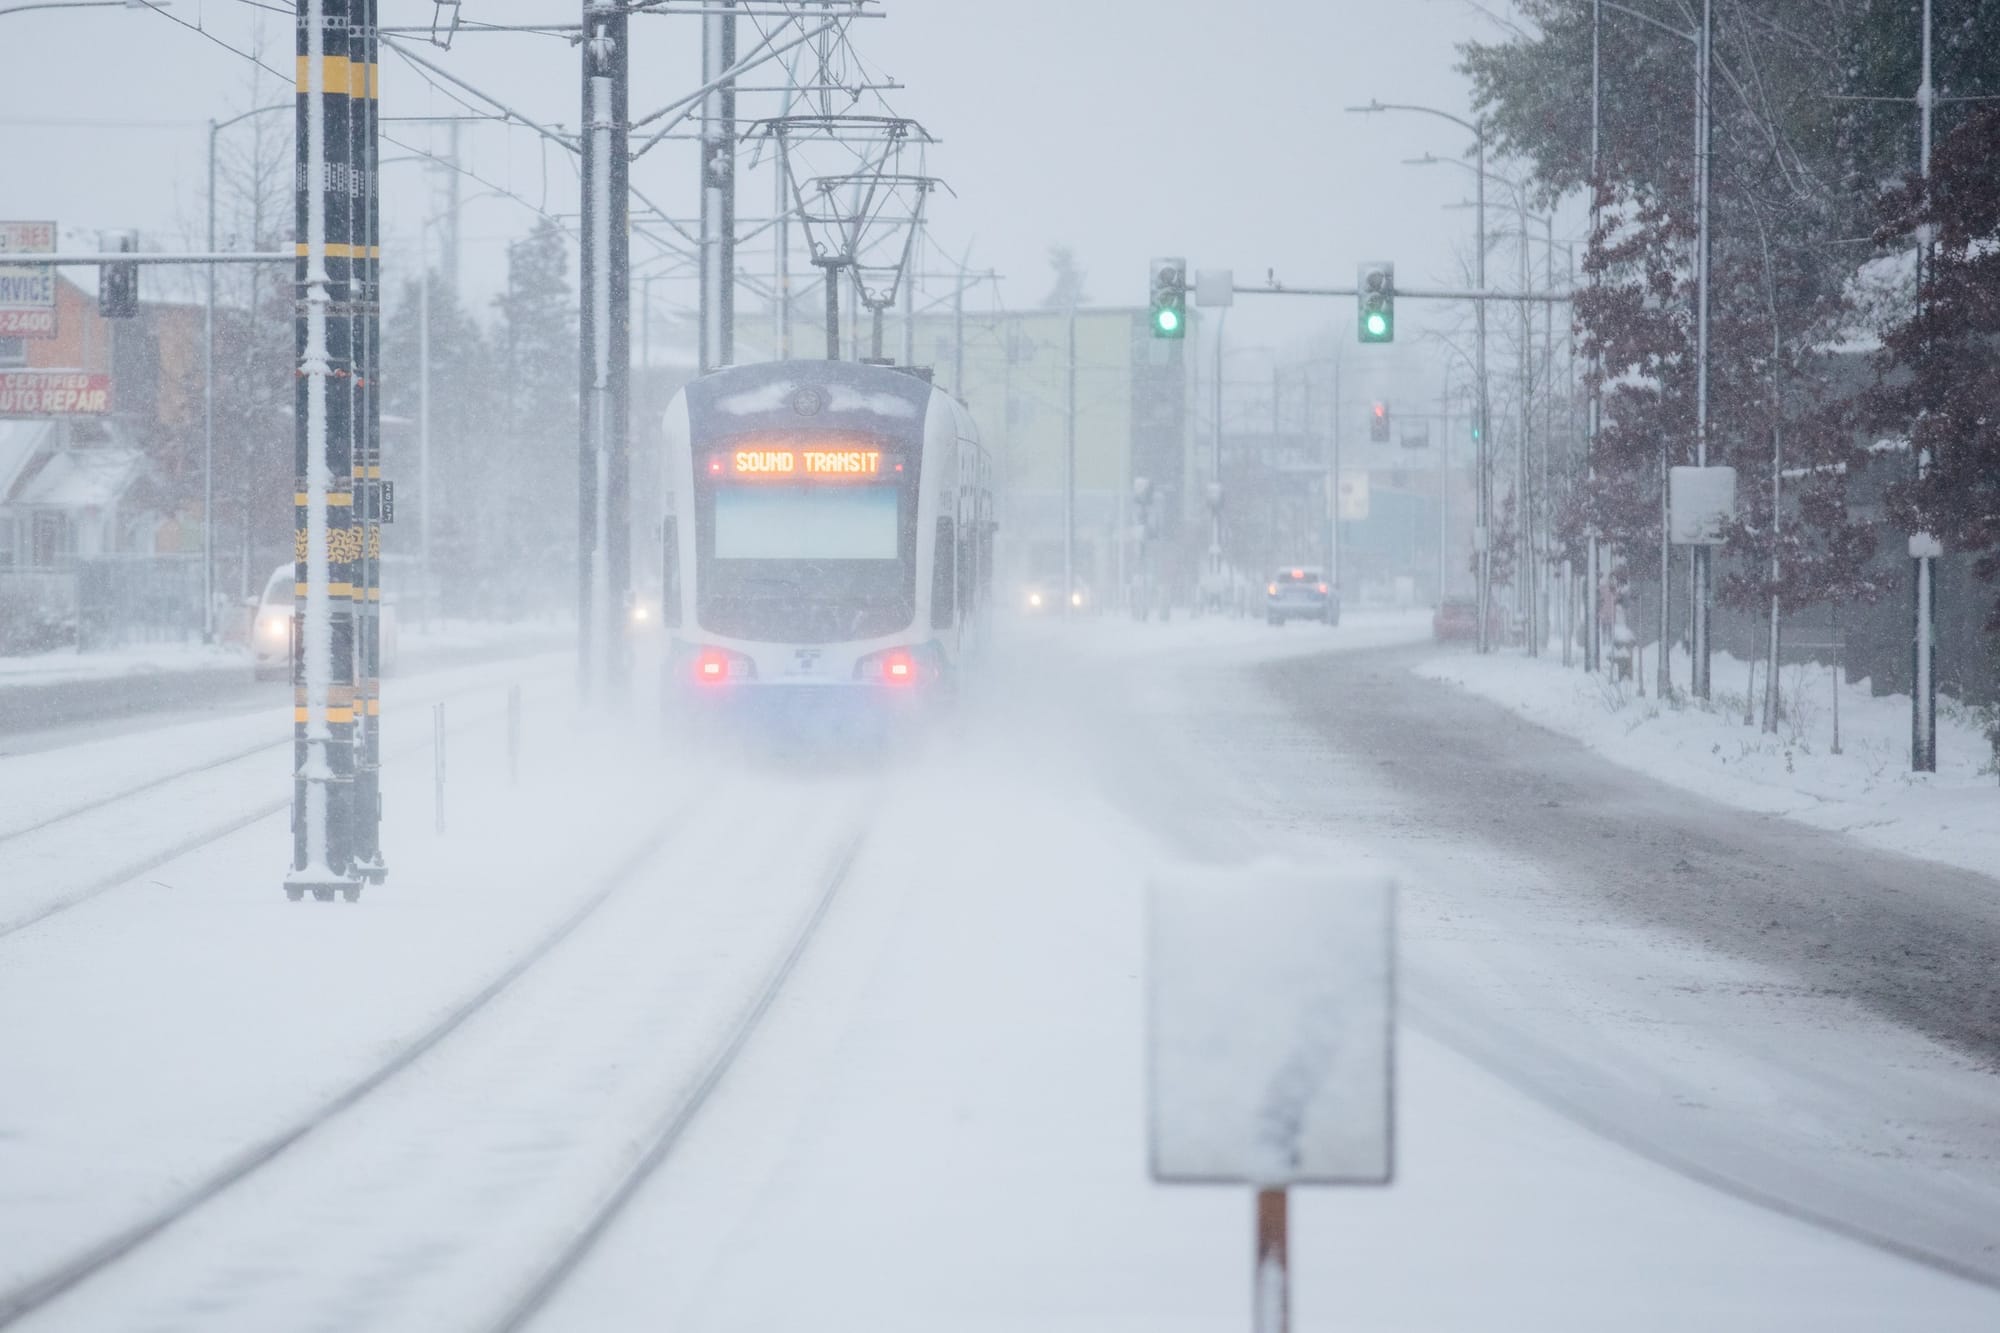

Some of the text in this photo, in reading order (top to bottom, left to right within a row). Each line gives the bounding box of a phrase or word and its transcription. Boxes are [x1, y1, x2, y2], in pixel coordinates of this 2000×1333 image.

[0, 312, 50, 331] -2400
[5, 373, 89, 389] CERTIFIED
[41, 388, 107, 412] REPAIR
[736, 452, 879, 473] SOUND TRANSIT
